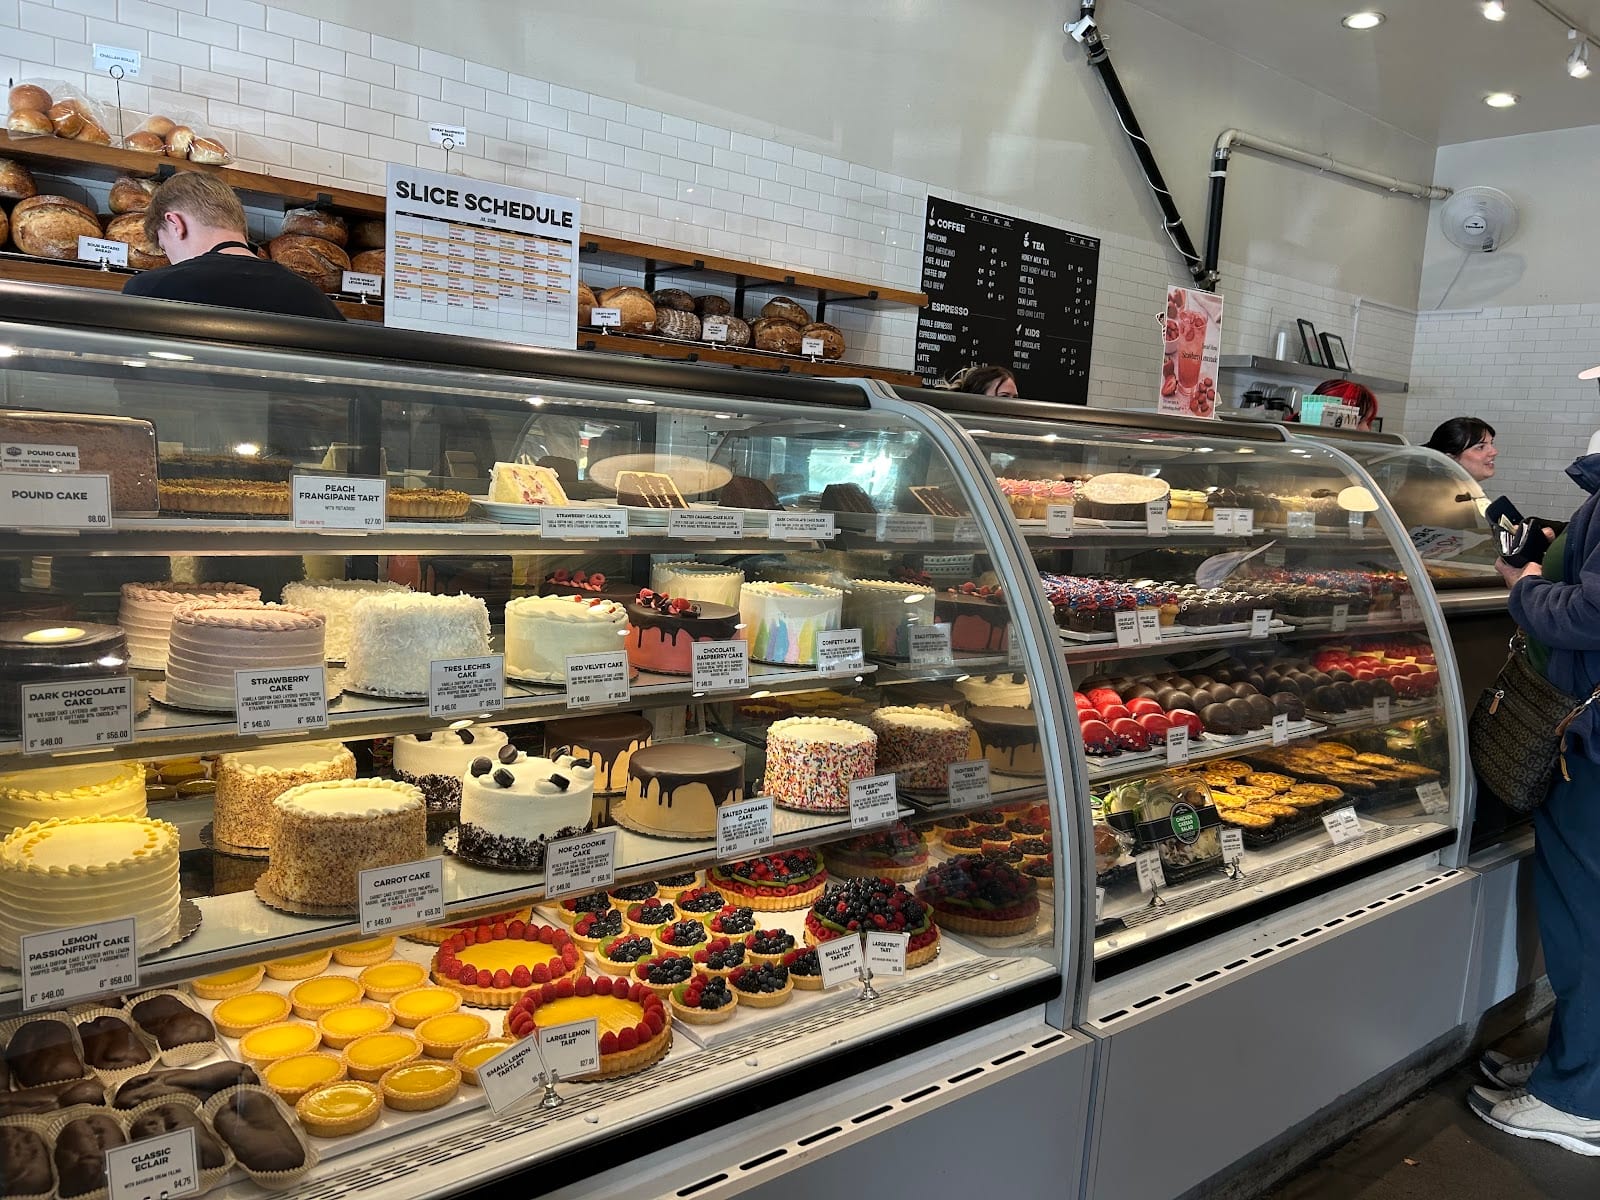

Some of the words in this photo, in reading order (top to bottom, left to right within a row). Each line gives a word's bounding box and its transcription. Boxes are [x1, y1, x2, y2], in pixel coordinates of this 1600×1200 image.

[395, 180, 459, 208] SLICE
[464, 193, 573, 228] SCHEDULE
[937, 219, 966, 233] COFFEE
[927, 232, 947, 243] AMERICANO
[935, 246, 956, 257] AMERICANO
[1032, 241, 1045, 252] TEA
[931, 302, 969, 316] ESPRESSO
[1026, 299, 1038, 308] LATTE
[934, 320, 953, 331] ESPRESSO
[1025, 328, 1040, 338] KIDS
[917, 354, 930, 362] LATTE
[325, 484, 355, 493] PEACH
[12, 490, 54, 500] POUND
[56, 492, 88, 500] CAKE
[299, 492, 356, 501] FRANGIPANE
[358, 494, 380, 502] TART
[88, 515, 106, 523] $8.00
[464, 663, 491, 671] LECHES
[251, 675, 310, 686] STRAWBERRY
[30, 692, 59, 701] DARK
[62, 686, 126, 698] CHOCOLATE
[64, 698, 93, 707] CAKE
[868, 781, 889, 789] BIRTHDAY
[723, 810, 743, 819] SALTED
[743, 805, 768, 814] CARAMEL
[1176, 815, 1193, 823] CHICKEN
[1178, 820, 1193, 828] CAESAR
[559, 845, 580, 854] NOE-O
[581, 840, 606, 849] COOKIE
[573, 849, 591, 858] CAKE
[374, 875, 408, 888] CARROT
[409, 872, 430, 881] CAKE
[62, 933, 98, 946] LEMON
[29, 941, 101, 961] PASSIONFRUIT
[103, 936, 130, 947] CAKE
[825, 948, 841, 957] SMALL
[841, 944, 855, 953] FRUIT
[831, 951, 851, 961] TARTLET
[30, 963, 48, 971] VANILLA
[81, 953, 101, 961] LAYERED
[65, 966, 96, 976] BUTTERCREAM
[110, 974, 132, 986] $58.00
[41, 988, 65, 1000] $48.00
[546, 1033, 567, 1043] LARGE
[569, 1029, 590, 1039] LEMON
[560, 1039, 577, 1047] TART
[487, 1061, 509, 1078] SMALL
[508, 1047, 531, 1064] LEMON
[497, 1058, 525, 1078] TARTLET
[131, 1147, 172, 1164] CLASSIC
[135, 1157, 169, 1172] ECLAIR
[174, 1176, 191, 1189] $4.75
